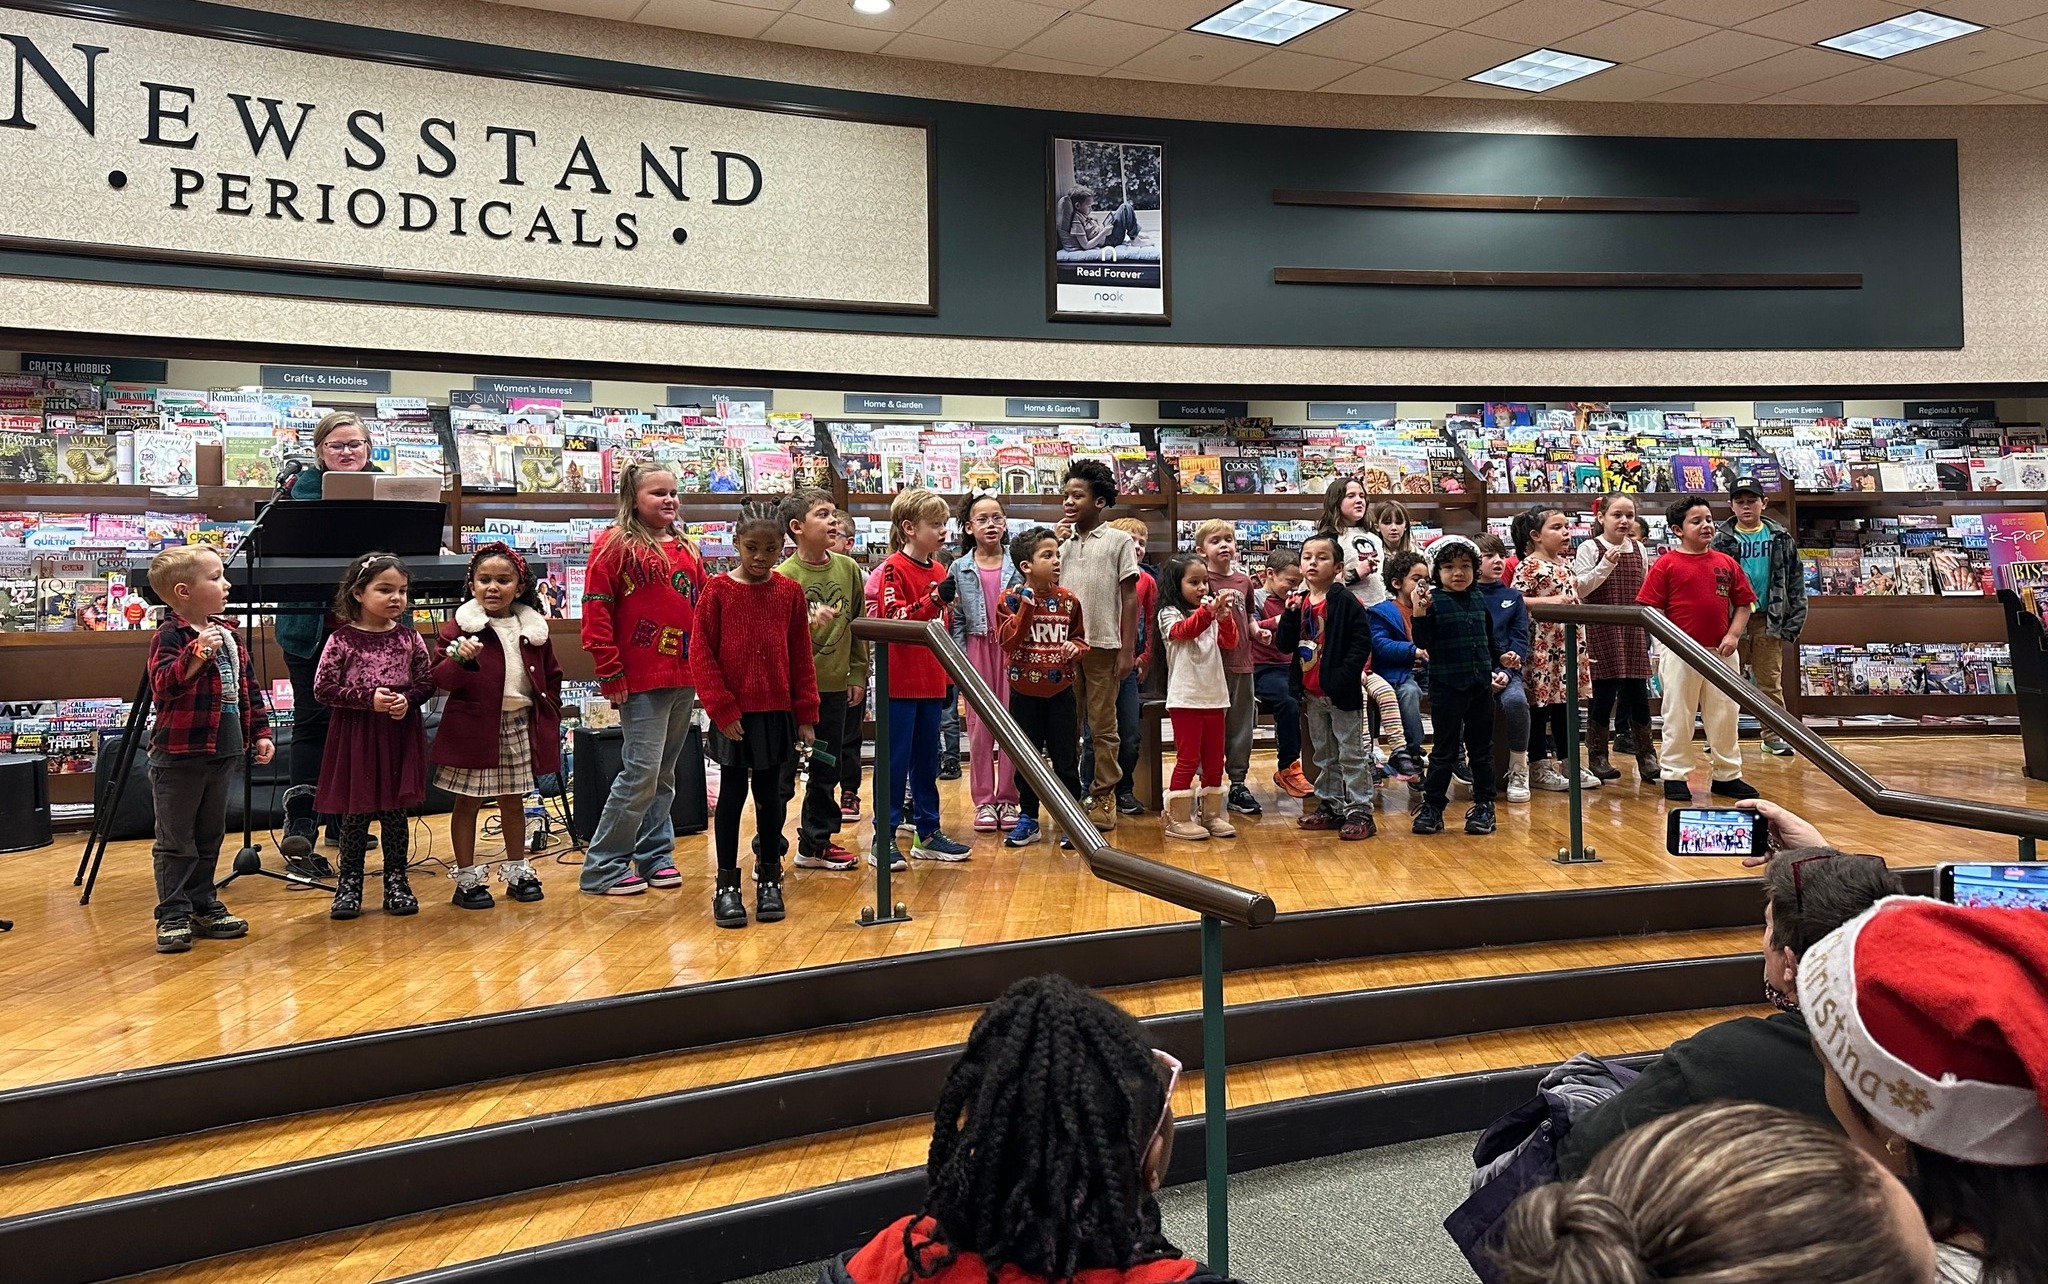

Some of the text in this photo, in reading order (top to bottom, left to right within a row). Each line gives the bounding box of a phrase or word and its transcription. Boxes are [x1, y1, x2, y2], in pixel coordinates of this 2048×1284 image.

[0, 34, 764, 206] NEWSSTAND
[171, 168, 640, 250] PERIODICALS
[1077, 266, 1142, 279] Read Forever
[1094, 290, 1123, 302] nook
[29, 360, 111, 375] CRAFTS & HOBBIES
[283, 373, 368, 386] Crafts & Hobbies
[494, 383, 573, 395] Women's Interest
[106, 391, 155, 400] TAYLOR SWIFT
[212, 392, 260, 402] Romantasy
[452, 393, 505, 404] ELYSIAN
[712, 393, 730, 402] Kids
[46, 398, 78, 410] ards
[863, 400, 924, 409] Home & Garden
[1024, 404, 1081, 413] Home & Garden
[290, 408, 317, 419] TOOL
[1181, 406, 1198, 414] Food
[1207, 407, 1226, 415] Wine
[1346, 407, 1357, 415] Art
[1774, 406, 1824, 414] Current Events
[1918, 406, 1950, 415] Regional
[1957, 406, 1979, 414] Travel
[107, 417, 159, 425] CHRISTMAS
[286, 420, 317, 430] Machini
[1628, 413, 1664, 430] BTS
[367, 423, 384, 431] VING
[1756, 428, 1793, 436] PHARAOHS
[1930, 429, 1964, 438] GHOSTS
[70, 435, 105, 444] WHAT
[390, 435, 436, 444] woodworking
[1202, 437, 1227, 447] THRIVE
[523, 447, 553, 455] WHAT
[701, 447, 742, 458] VOGUE
[1279, 450, 1297, 458] 13x9
[1889, 448, 1913, 456] JACOBIN
[1685, 481, 1705, 489] CITY
[1239, 524, 1268, 533] SOUPS
[190, 532, 225, 541] CROCH
[1965, 538, 1988, 547] Brita
[551, 547, 581, 555] Energy
[1971, 550, 1988, 560] Trav
[97, 557, 133, 568] Croch
[1243, 554, 1270, 562] PUMPKI
[2015, 563, 2042, 580] BTS
[1024, 623, 1069, 643] ARVEL
[560, 690, 592, 698] ALTHY
[0, 703, 42, 717] AFV
[63, 720, 96, 728] Model
[50, 739, 91, 749] TRAINS
